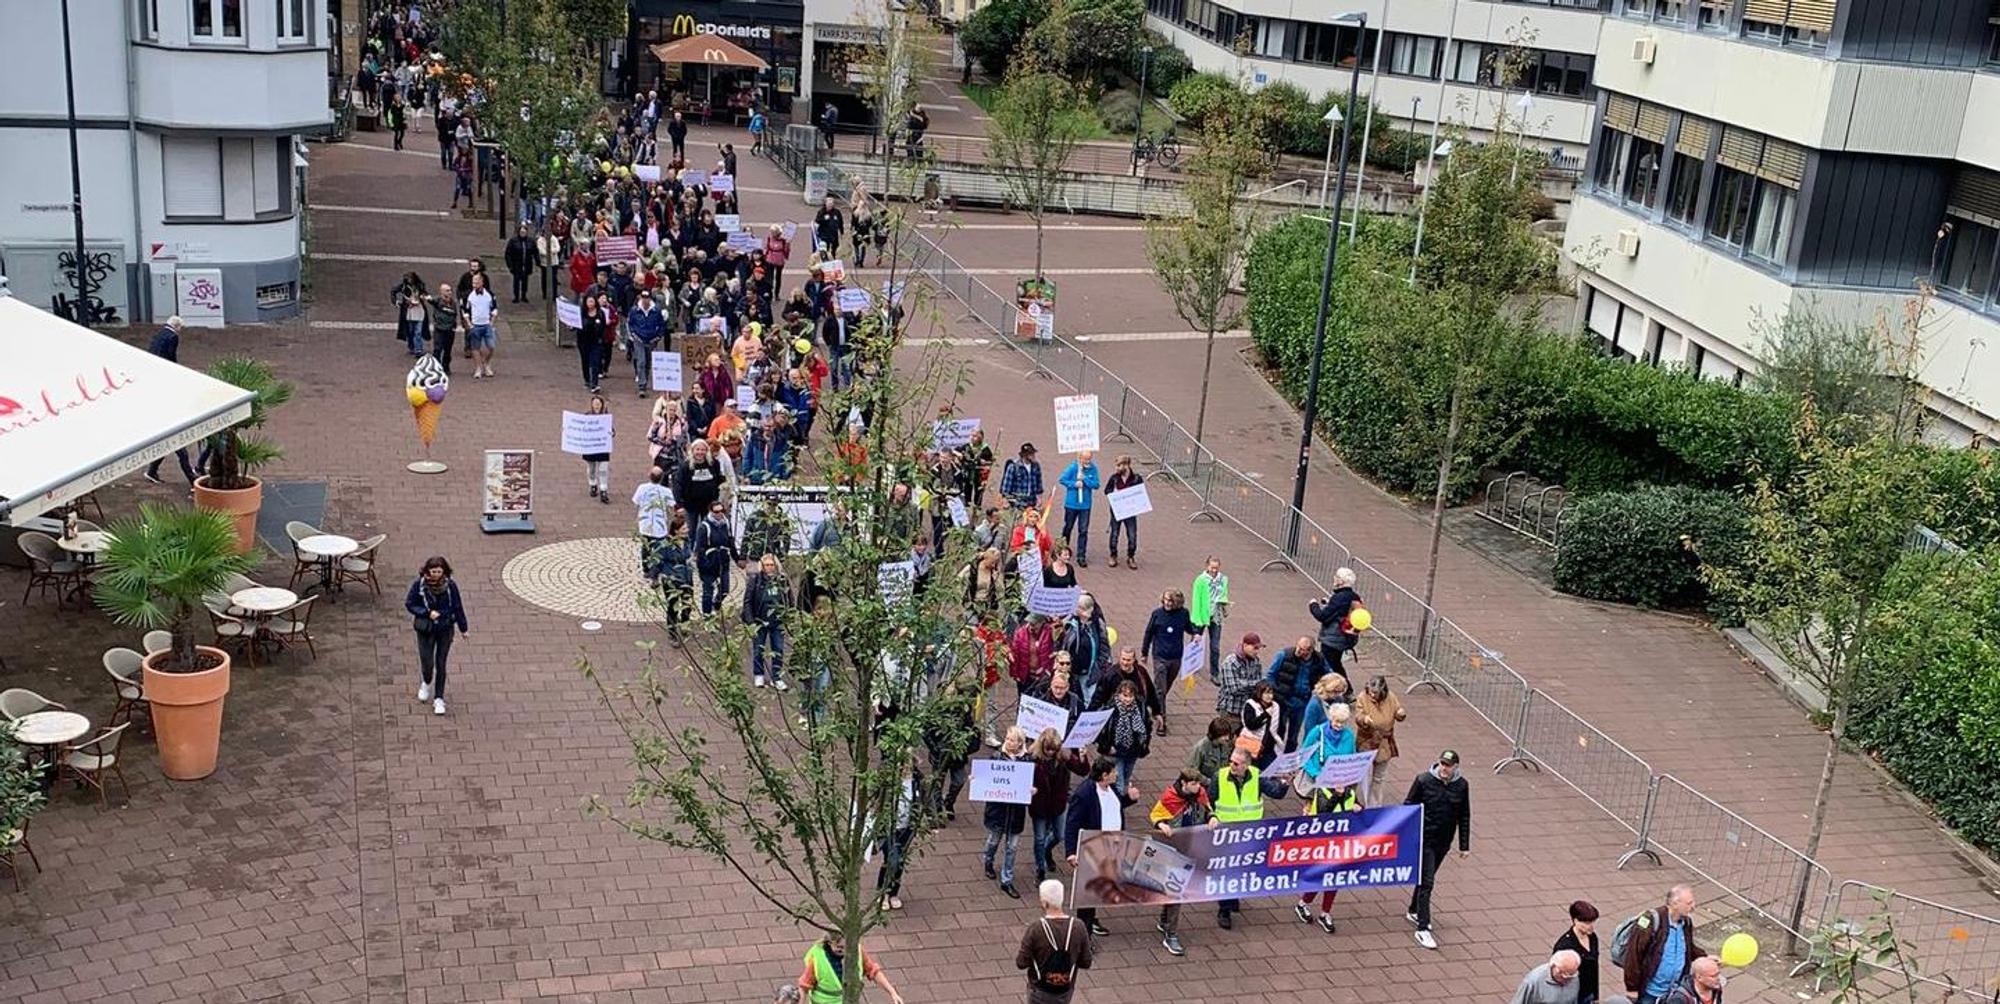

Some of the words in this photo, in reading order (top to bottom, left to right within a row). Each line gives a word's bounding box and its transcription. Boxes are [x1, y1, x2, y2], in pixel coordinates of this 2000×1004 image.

[673, 15, 771, 39] McDonald's
[990, 763, 1015, 772] Lasst
[992, 776, 1011, 785] uns
[984, 788, 1018, 800] reden!
[1212, 825, 1279, 846] Unser
[1283, 817, 1350, 838] Leben
[1207, 850, 1267, 870] muss
[1272, 838, 1394, 864] bezahlbar
[1204, 870, 1300, 896] bleiben!
[1322, 866, 1413, 888] REK-NRW
